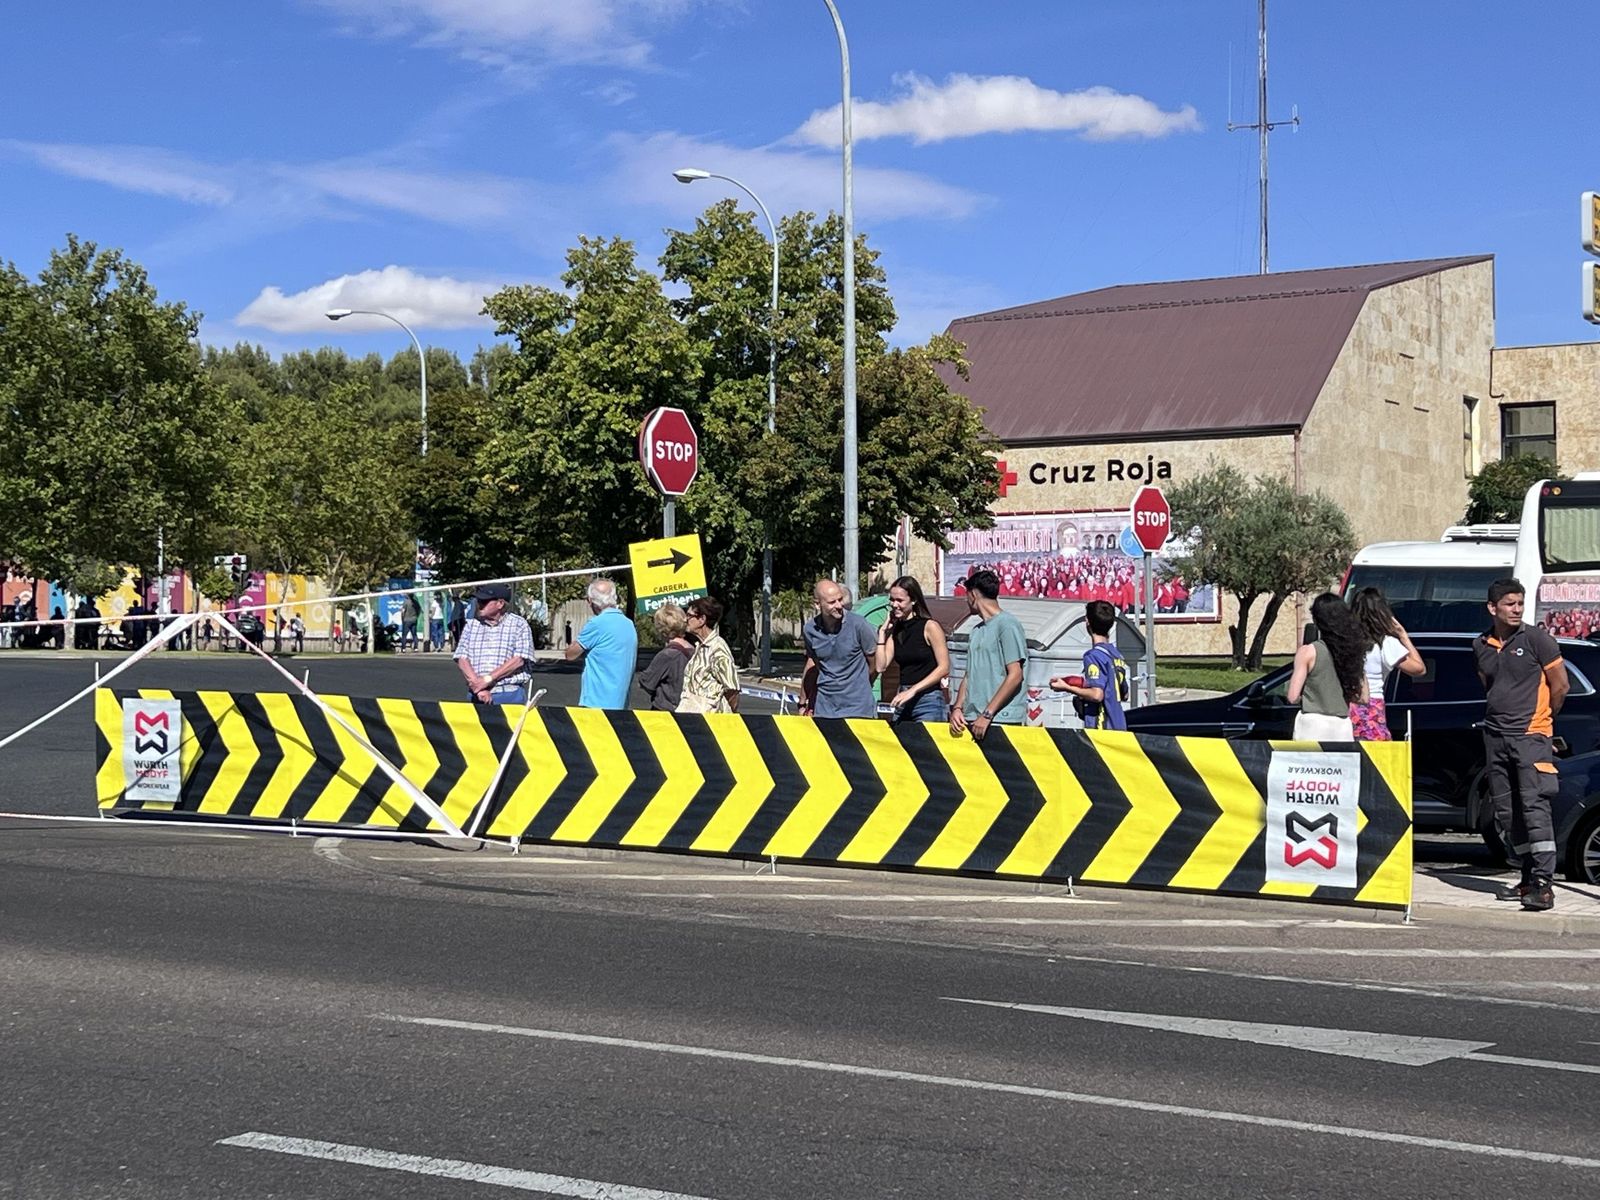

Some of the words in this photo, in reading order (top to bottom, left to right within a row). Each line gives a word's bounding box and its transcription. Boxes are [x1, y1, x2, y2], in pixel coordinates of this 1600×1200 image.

[655, 440, 693, 463] STOP
[1029, 462, 1096, 485] Cruz
[1107, 454, 1172, 485] Roja
[1136, 510, 1167, 527] STOP
[966, 528, 992, 554] AÑOS
[992, 529, 1025, 553] CERCA
[1025, 528, 1039, 553] DE
[653, 582, 689, 594] CARRERA
[1540, 584, 1556, 602] 150
[1555, 582, 1577, 602] AÑOS
[134, 760, 168, 769] WÜRTH
[1288, 766, 1343, 775] WORKWEAR
[135, 769, 169, 778] MODYF
[1286, 780, 1341, 792] MODYF
[1286, 791, 1340, 805] WÜRTH
